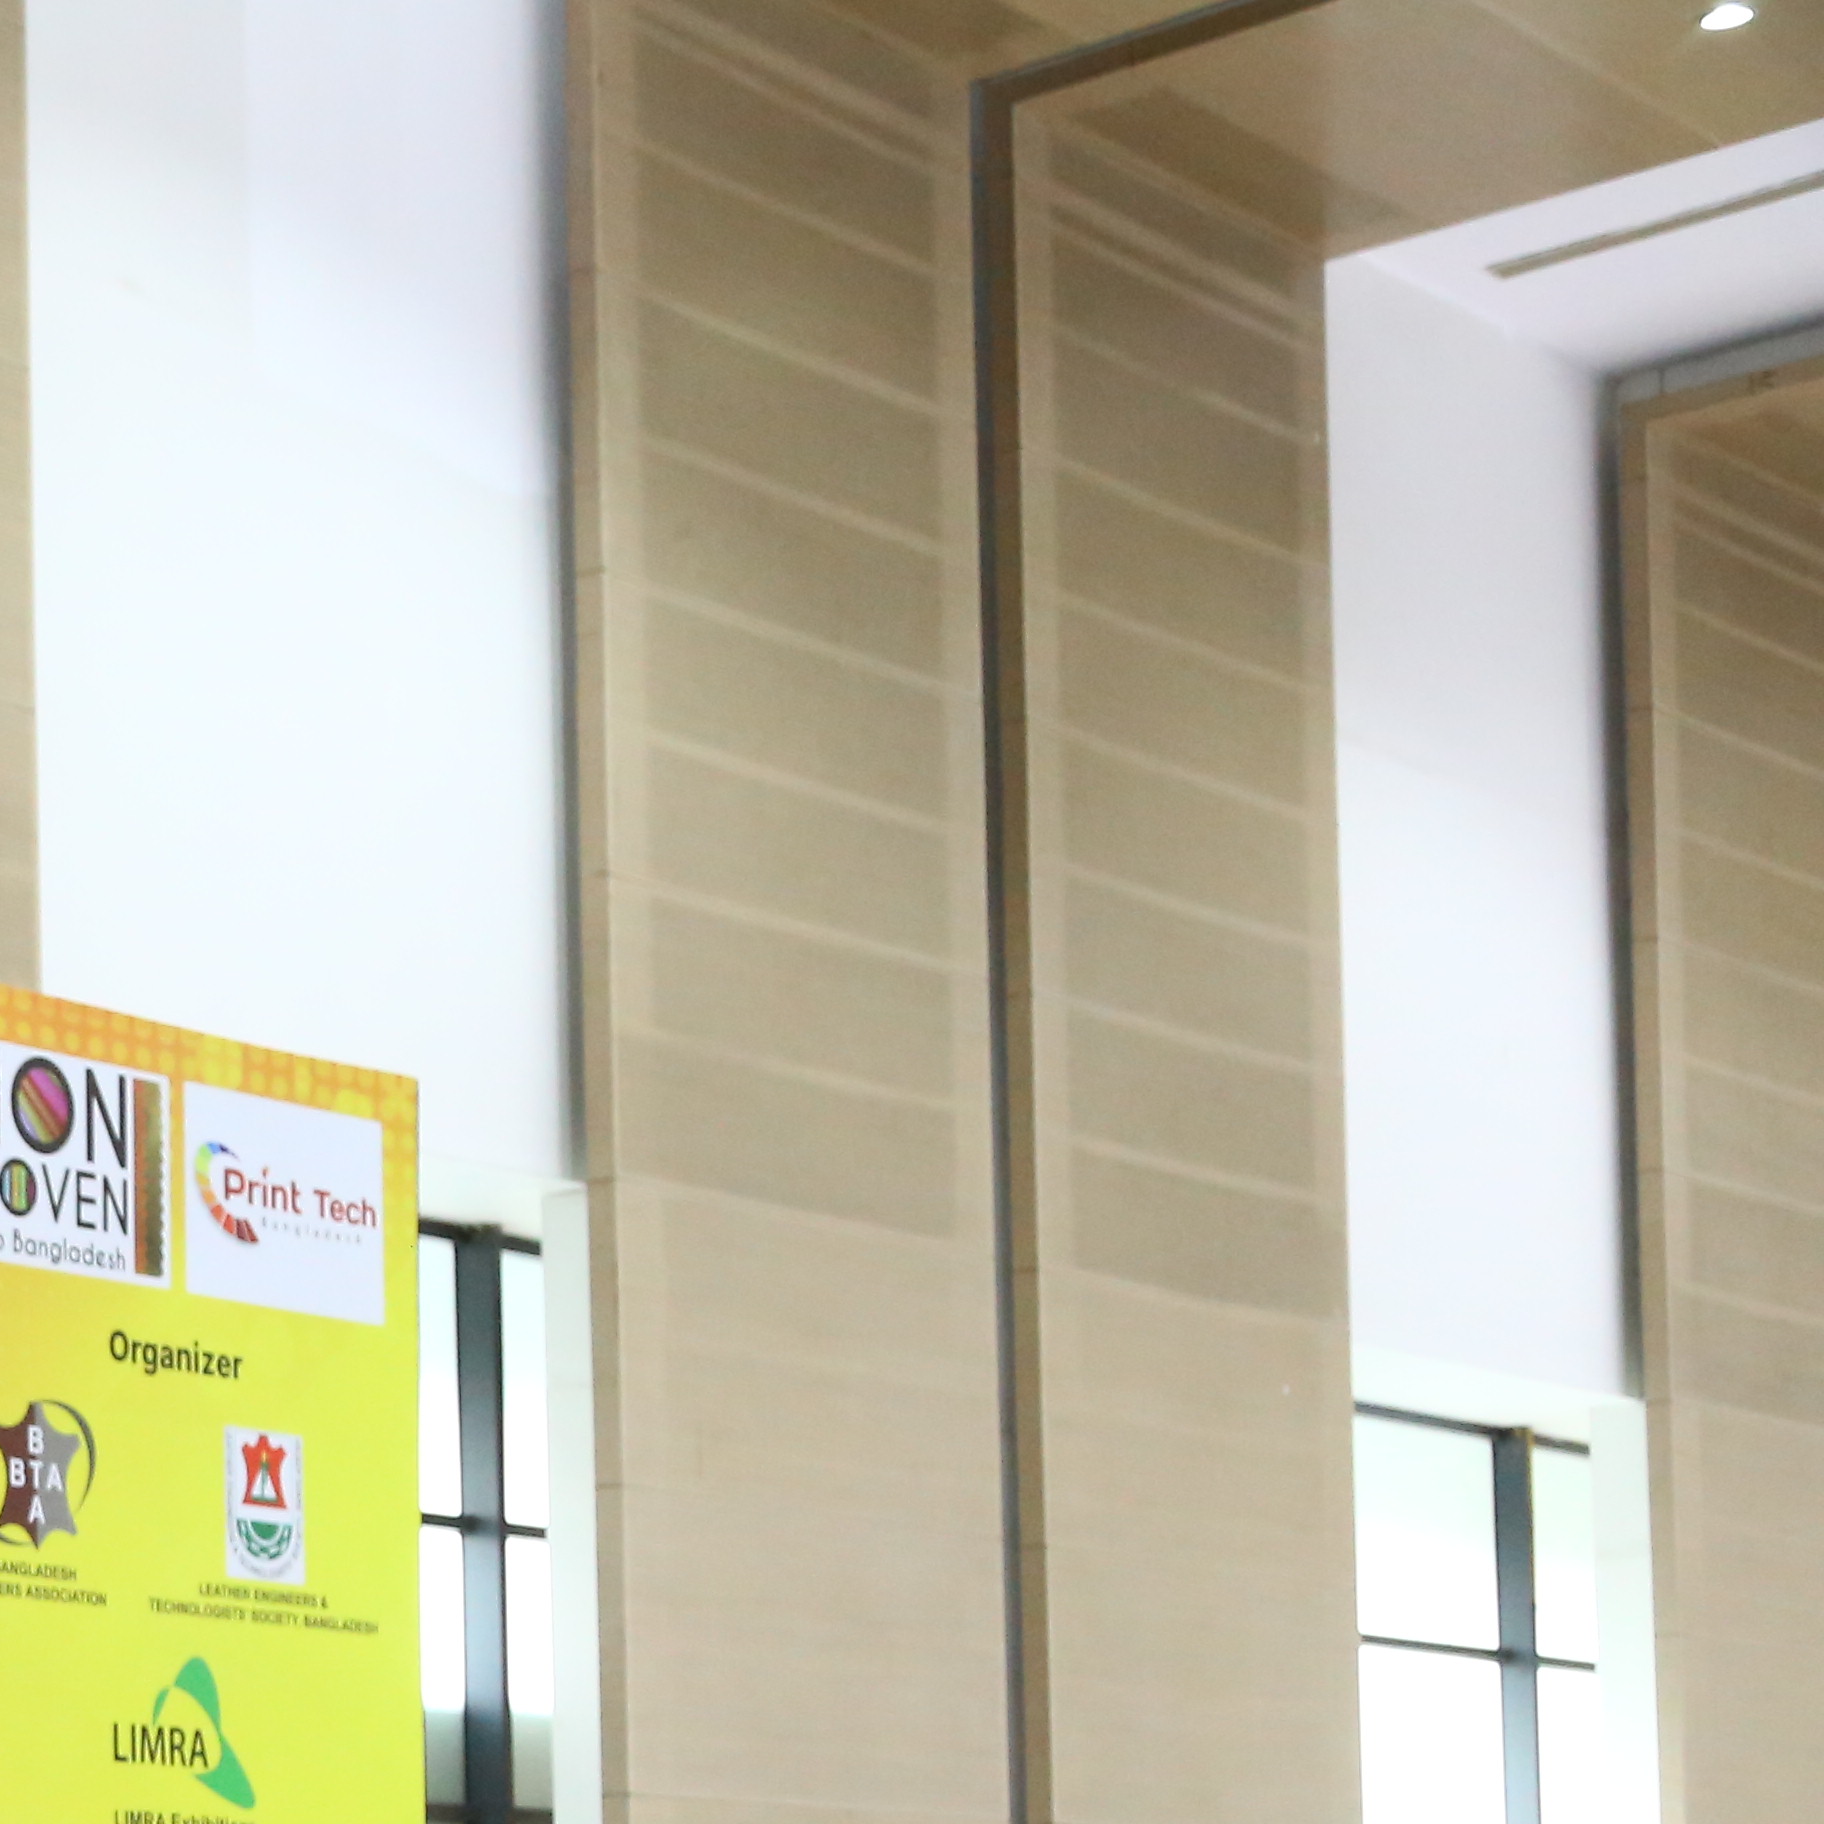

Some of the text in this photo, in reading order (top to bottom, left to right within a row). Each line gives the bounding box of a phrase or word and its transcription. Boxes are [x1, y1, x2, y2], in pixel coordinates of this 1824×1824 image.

[223, 1166, 377, 1228] Print Tech
[12, 1225, 126, 1272] Bangladesh
[109, 1330, 243, 1380] Organizer
[113, 1722, 209, 1769] LIMRA
